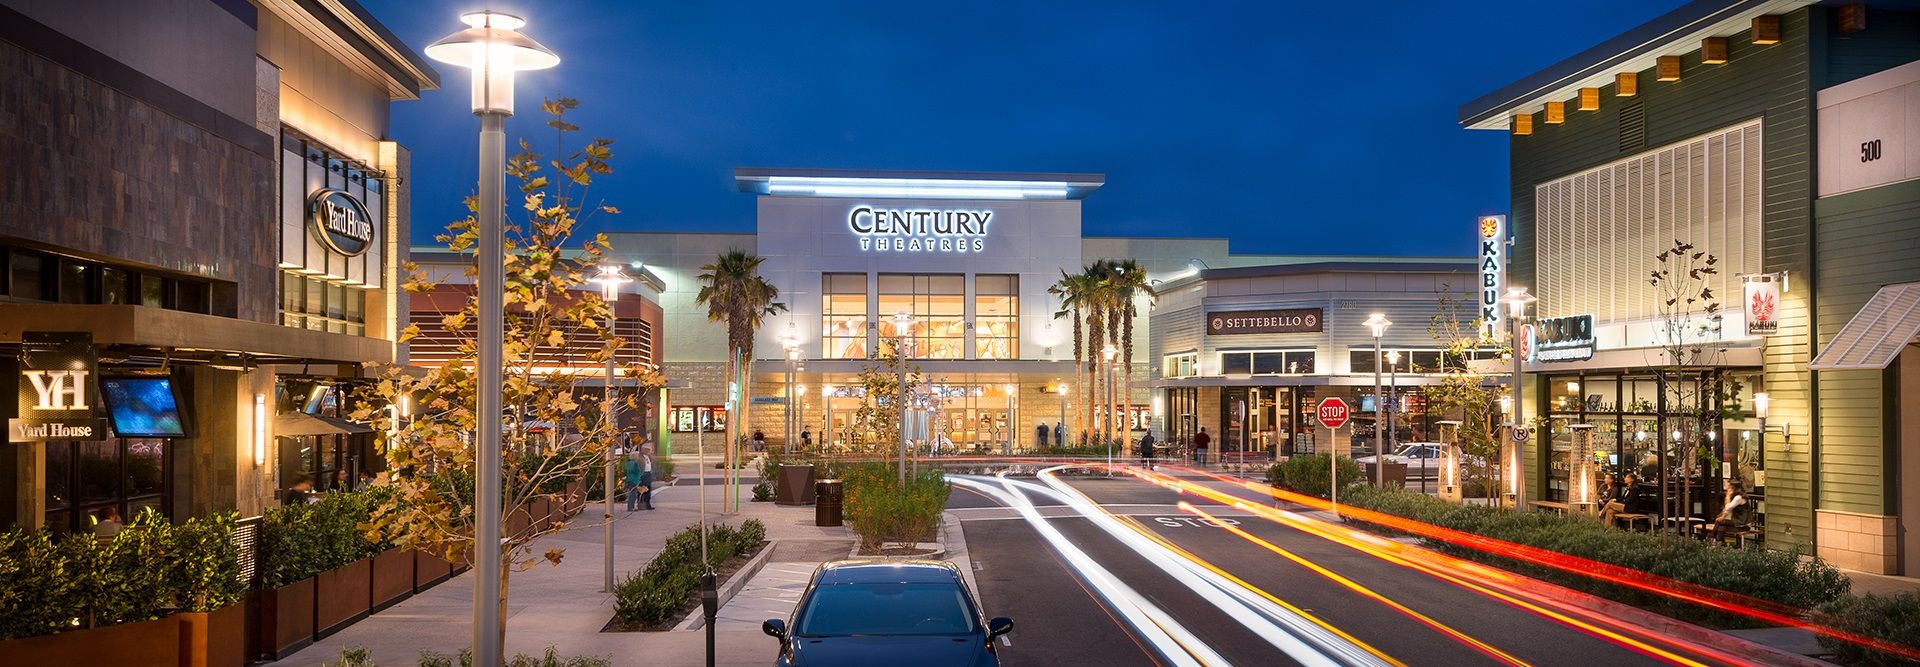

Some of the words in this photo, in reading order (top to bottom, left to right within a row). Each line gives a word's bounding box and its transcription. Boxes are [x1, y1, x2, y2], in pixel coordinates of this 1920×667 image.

[1861, 138, 1882, 163] 500
[326, 200, 346, 233] Yard
[347, 209, 371, 242] House
[850, 206, 992, 234] CENTURY
[861, 238, 983, 251] THEATRES
[1482, 240, 1498, 338] KABUKI
[1226, 315, 1302, 328] SETTEBELLO
[1533, 314, 1593, 345] KABUKI
[22, 370, 90, 411] YH
[1321, 406, 1345, 417] STOP
[18, 422, 48, 438] Yard
[50, 422, 92, 438] House
